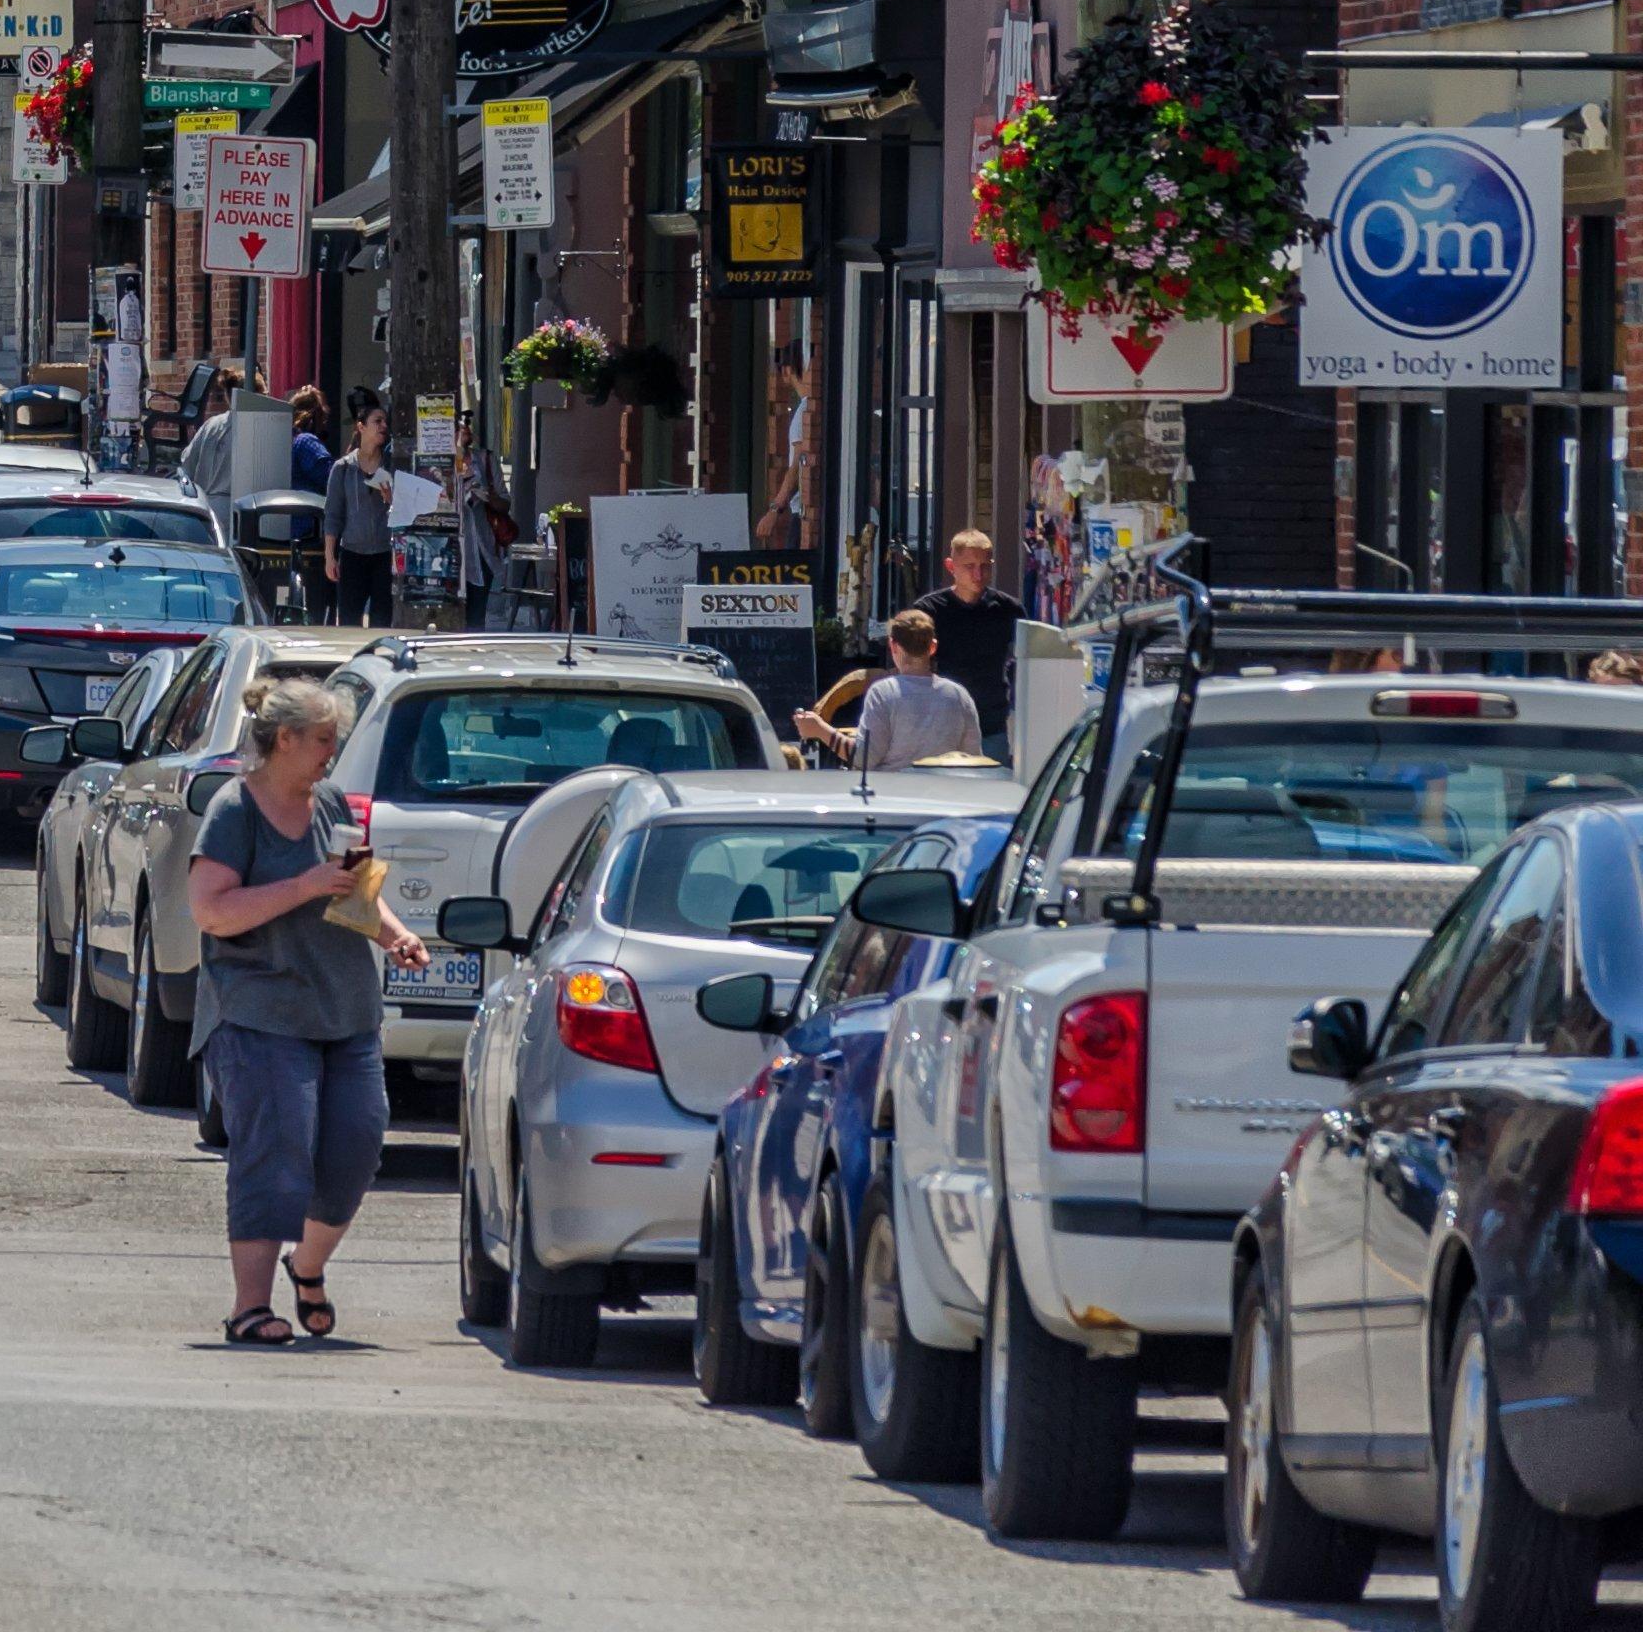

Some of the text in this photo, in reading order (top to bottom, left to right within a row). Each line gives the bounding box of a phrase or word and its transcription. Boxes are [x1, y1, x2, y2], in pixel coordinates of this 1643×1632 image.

[150, 85, 239, 105] Blanshard
[223, 149, 291, 168] PLEASE
[727, 155, 807, 178] LORI'S
[239, 170, 272, 187] PAY
[219, 188, 290, 208] HERE IN
[214, 210, 295, 228] ADVANCE
[1349, 199, 1513, 278] Om
[1305, 350, 1557, 380] yoga body home
[710, 564, 811, 586] LORI'S
[700, 593, 800, 614] SEXTON
[703, 617, 798, 626] IN THE CITY
[445, 960, 479, 984] 898
[386, 986, 444, 997] PICKERING
